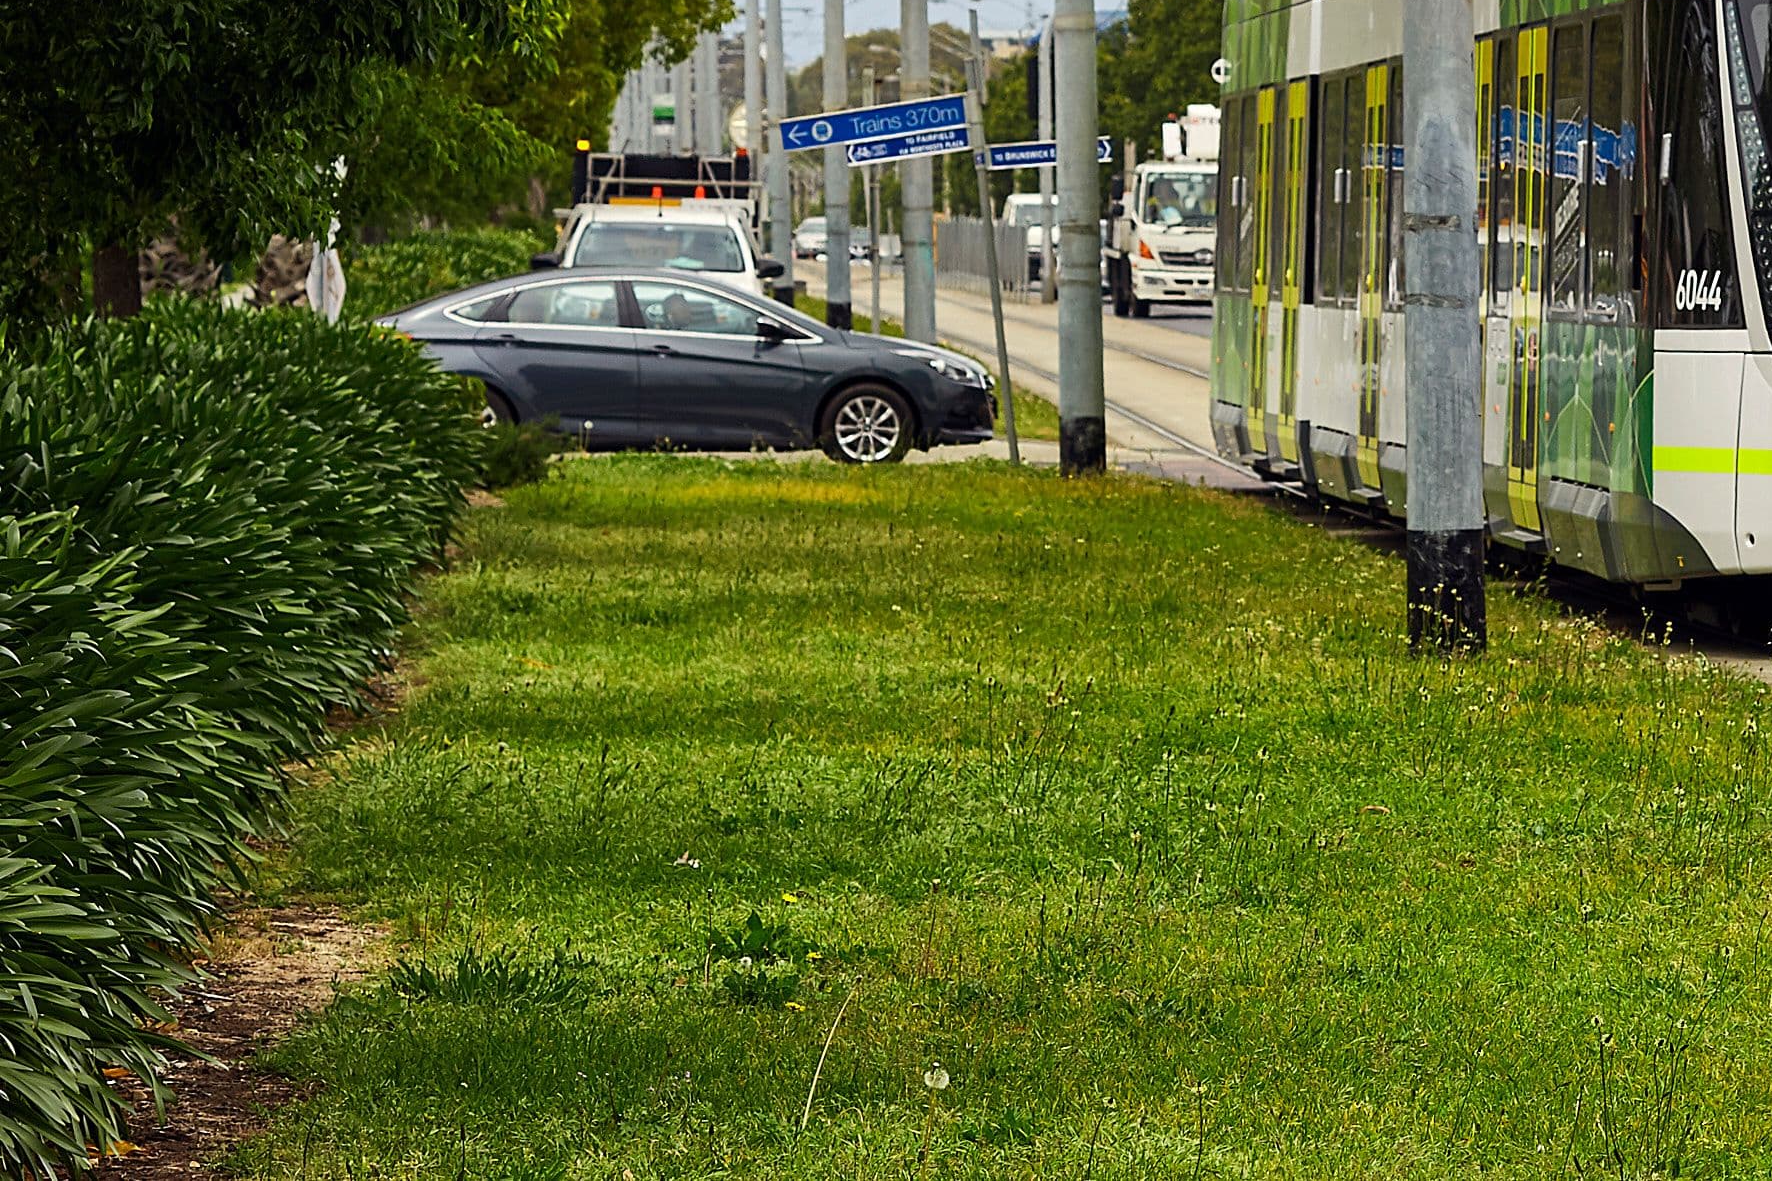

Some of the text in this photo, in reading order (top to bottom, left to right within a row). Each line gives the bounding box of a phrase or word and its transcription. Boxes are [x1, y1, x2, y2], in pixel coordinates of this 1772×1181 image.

[849, 106, 959, 136] Trains 370m
[916, 131, 956, 144] FAIRFIELD
[1004, 149, 1049, 161] BRUNSWICK
[1675, 269, 1722, 311] 6044
